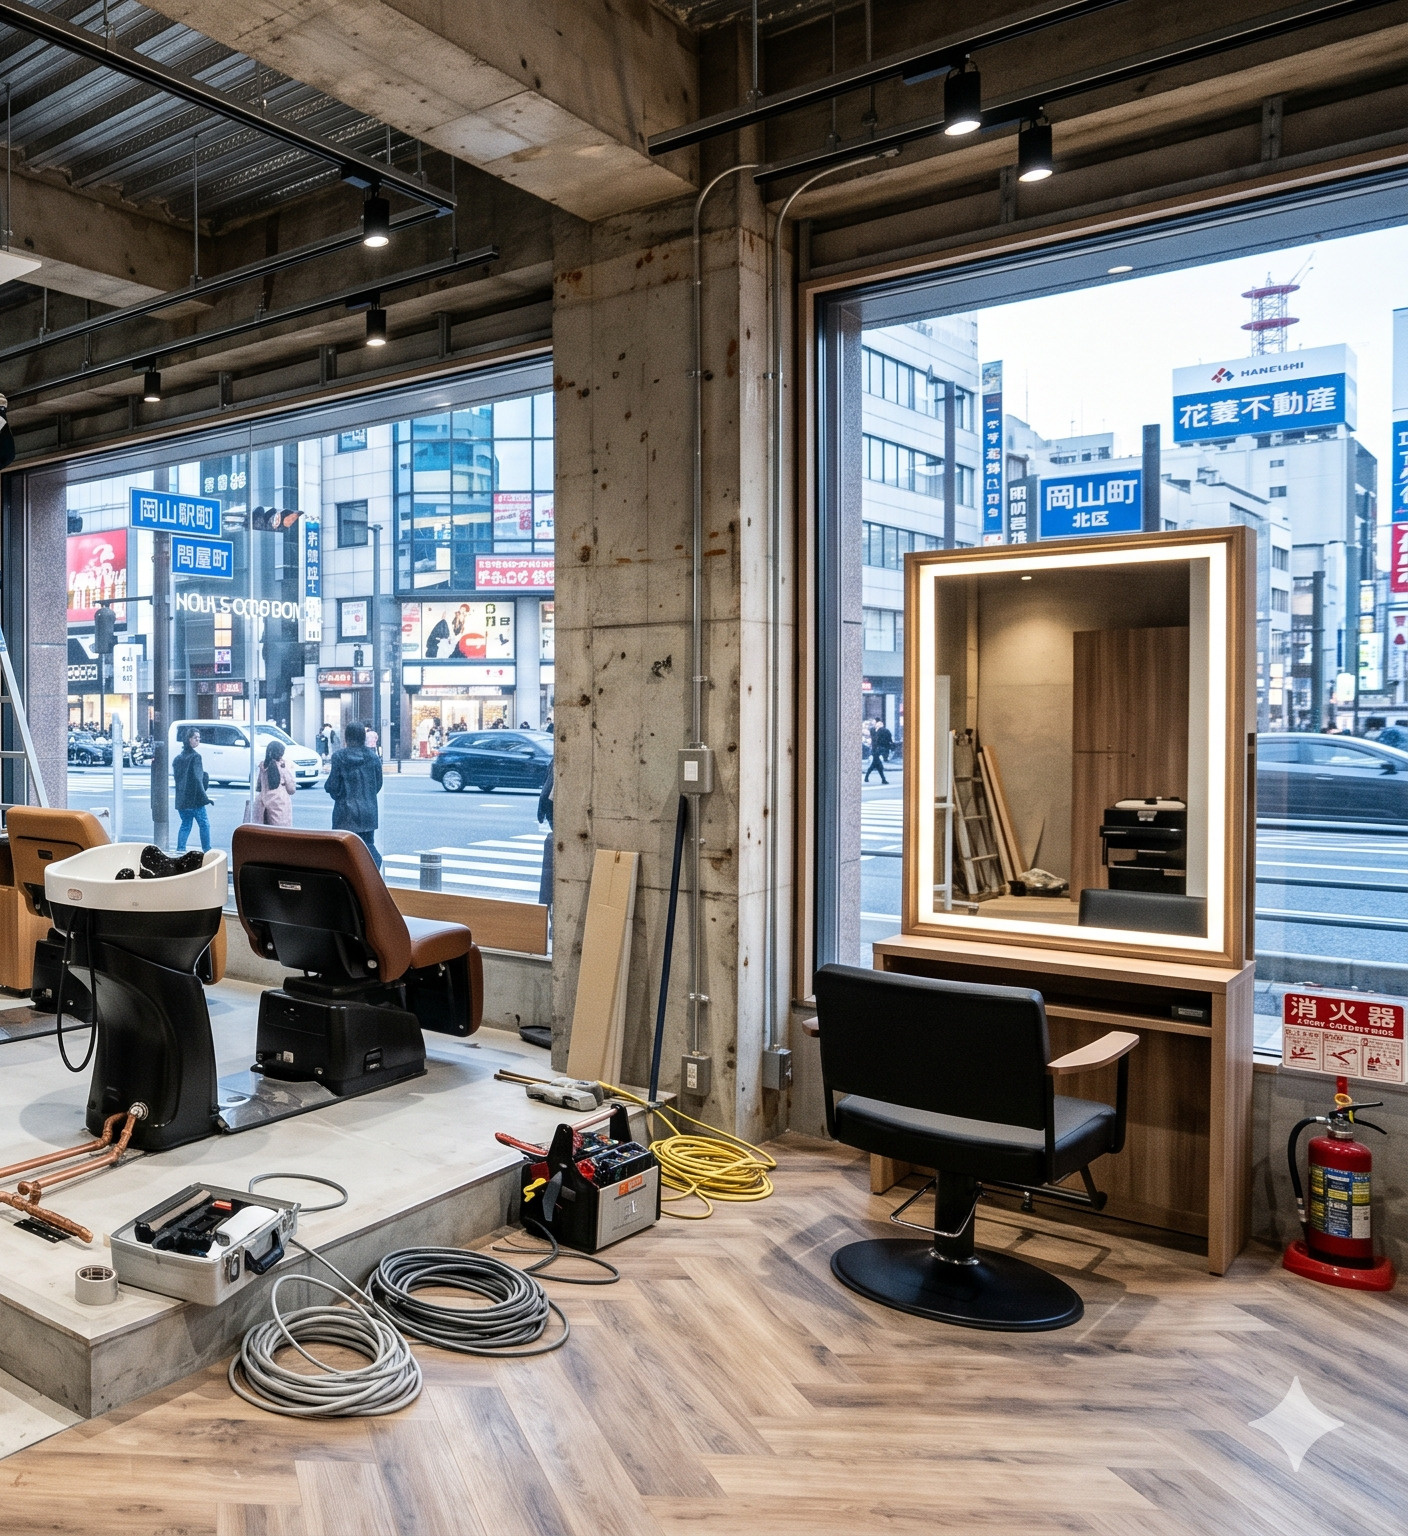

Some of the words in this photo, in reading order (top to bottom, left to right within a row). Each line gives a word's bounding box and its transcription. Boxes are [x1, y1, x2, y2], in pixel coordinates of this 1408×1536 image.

[1179, 386, 1337, 429] 花菱不動産
[1046, 479, 1138, 512] 岡山町
[139, 496, 214, 530] 岡山駅町
[1072, 510, 1109, 528] 北区
[176, 543, 229, 571] 問屋町
[1290, 997, 1396, 1028] 消火器
